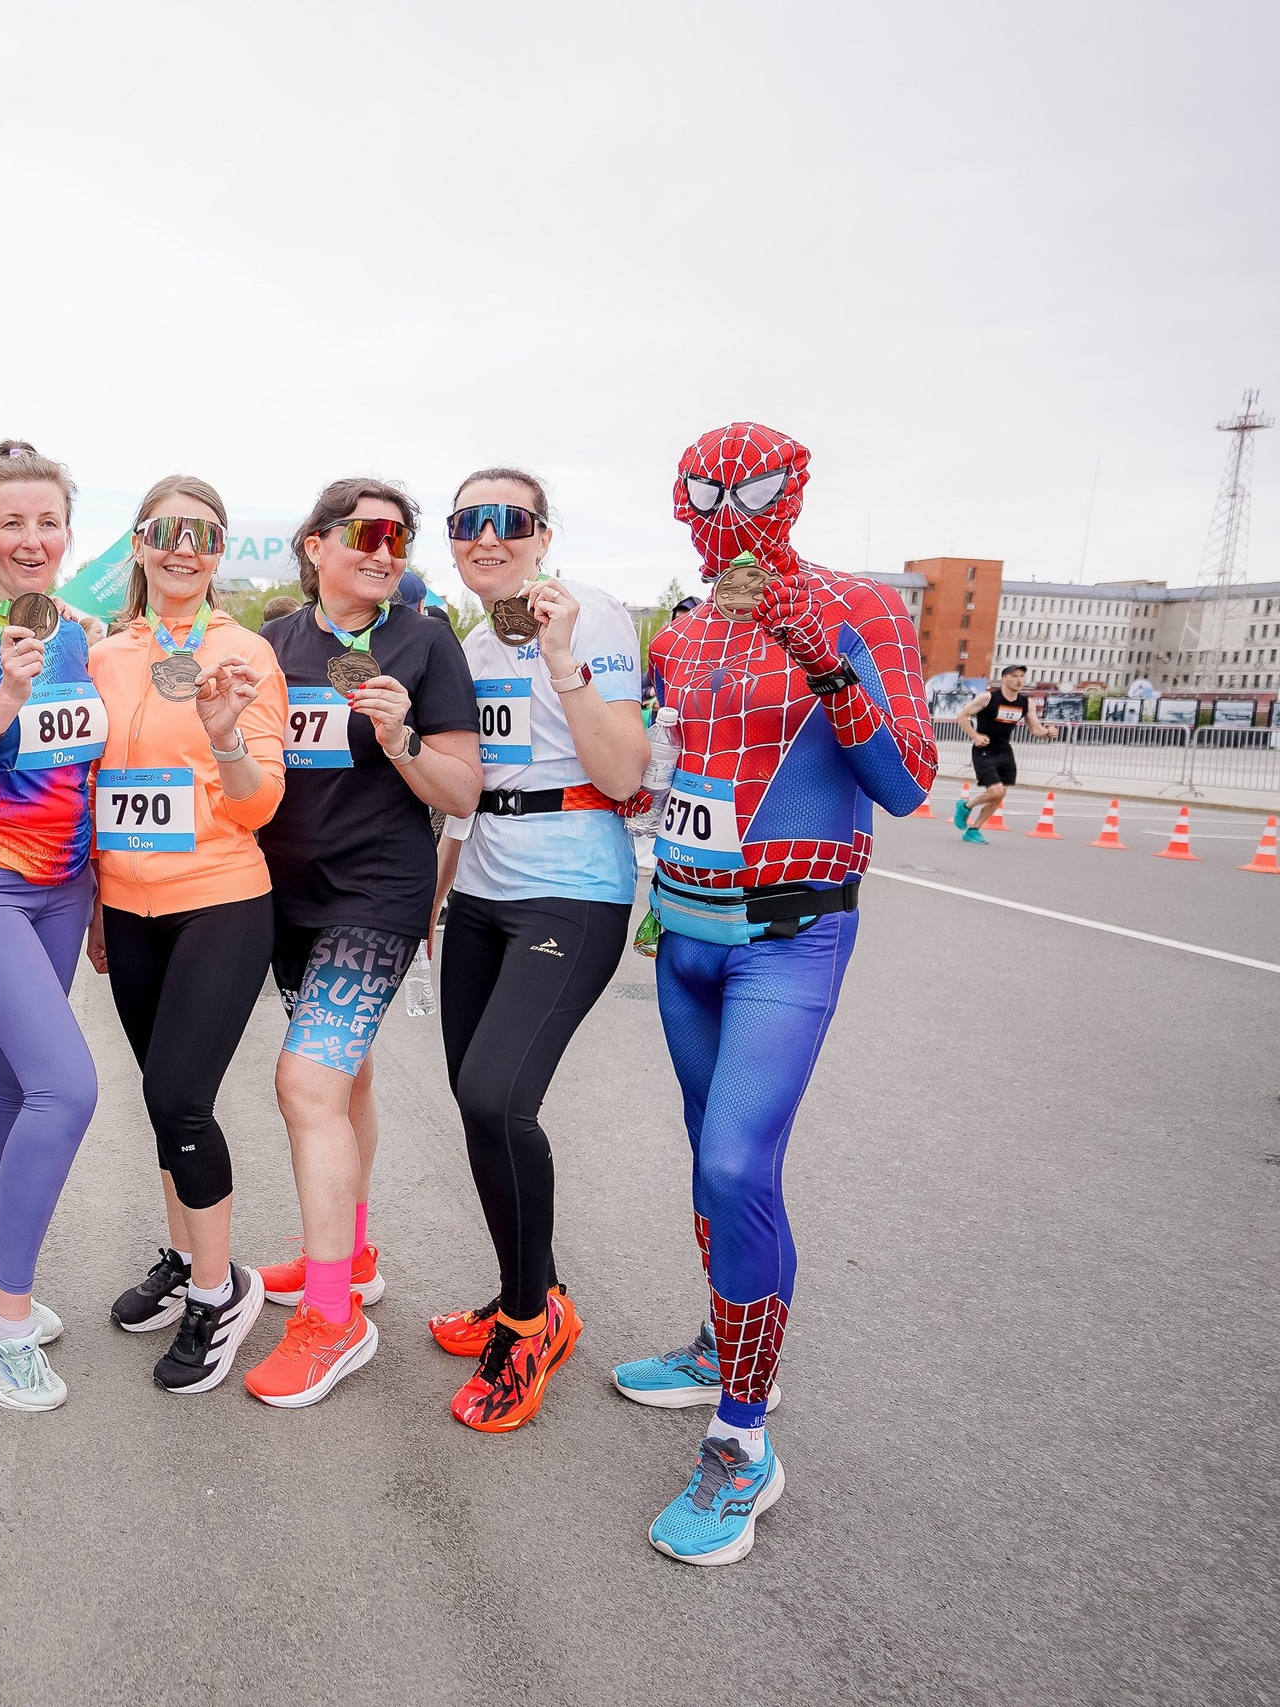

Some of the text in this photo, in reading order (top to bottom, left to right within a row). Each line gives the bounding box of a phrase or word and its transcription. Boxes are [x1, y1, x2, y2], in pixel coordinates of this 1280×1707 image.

[225, 537, 292, 561] ТАР
[39, 706, 91, 743] 802
[290, 711, 329, 743] 97
[477, 704, 512, 737] 00
[112, 793, 171, 825] 790
[665, 796, 711, 840] 570
[530, 945, 564, 957] DEMIX
